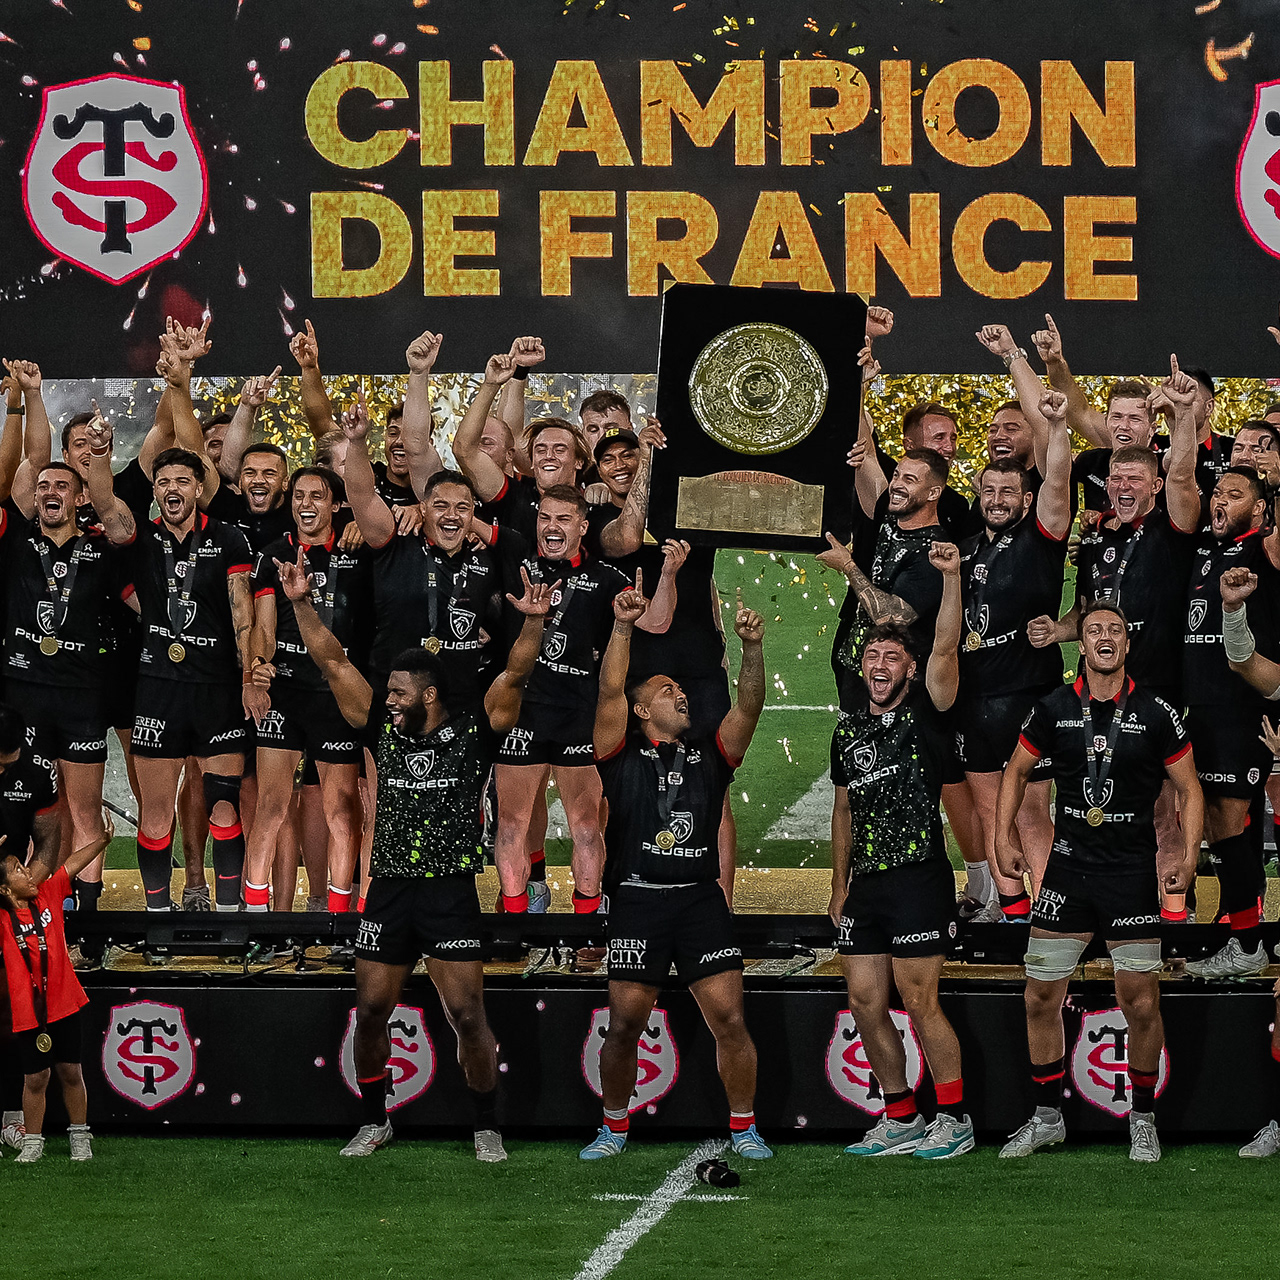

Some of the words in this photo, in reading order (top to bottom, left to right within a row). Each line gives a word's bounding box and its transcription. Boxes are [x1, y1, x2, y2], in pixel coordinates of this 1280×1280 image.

[304, 58, 1136, 167] CHAMPION
[310, 190, 501, 299] DE
[539, 190, 1139, 301] FRANCE
[1056, 720, 1085, 728] AIRBUS
[1154, 695, 1187, 739] actual
[132, 726, 164, 743] CITY
[387, 778, 459, 790] PEUGEOT
[610, 939, 647, 951] GREEN
[892, 930, 940, 945] AKKODIS
[610, 949, 646, 964] CITY
